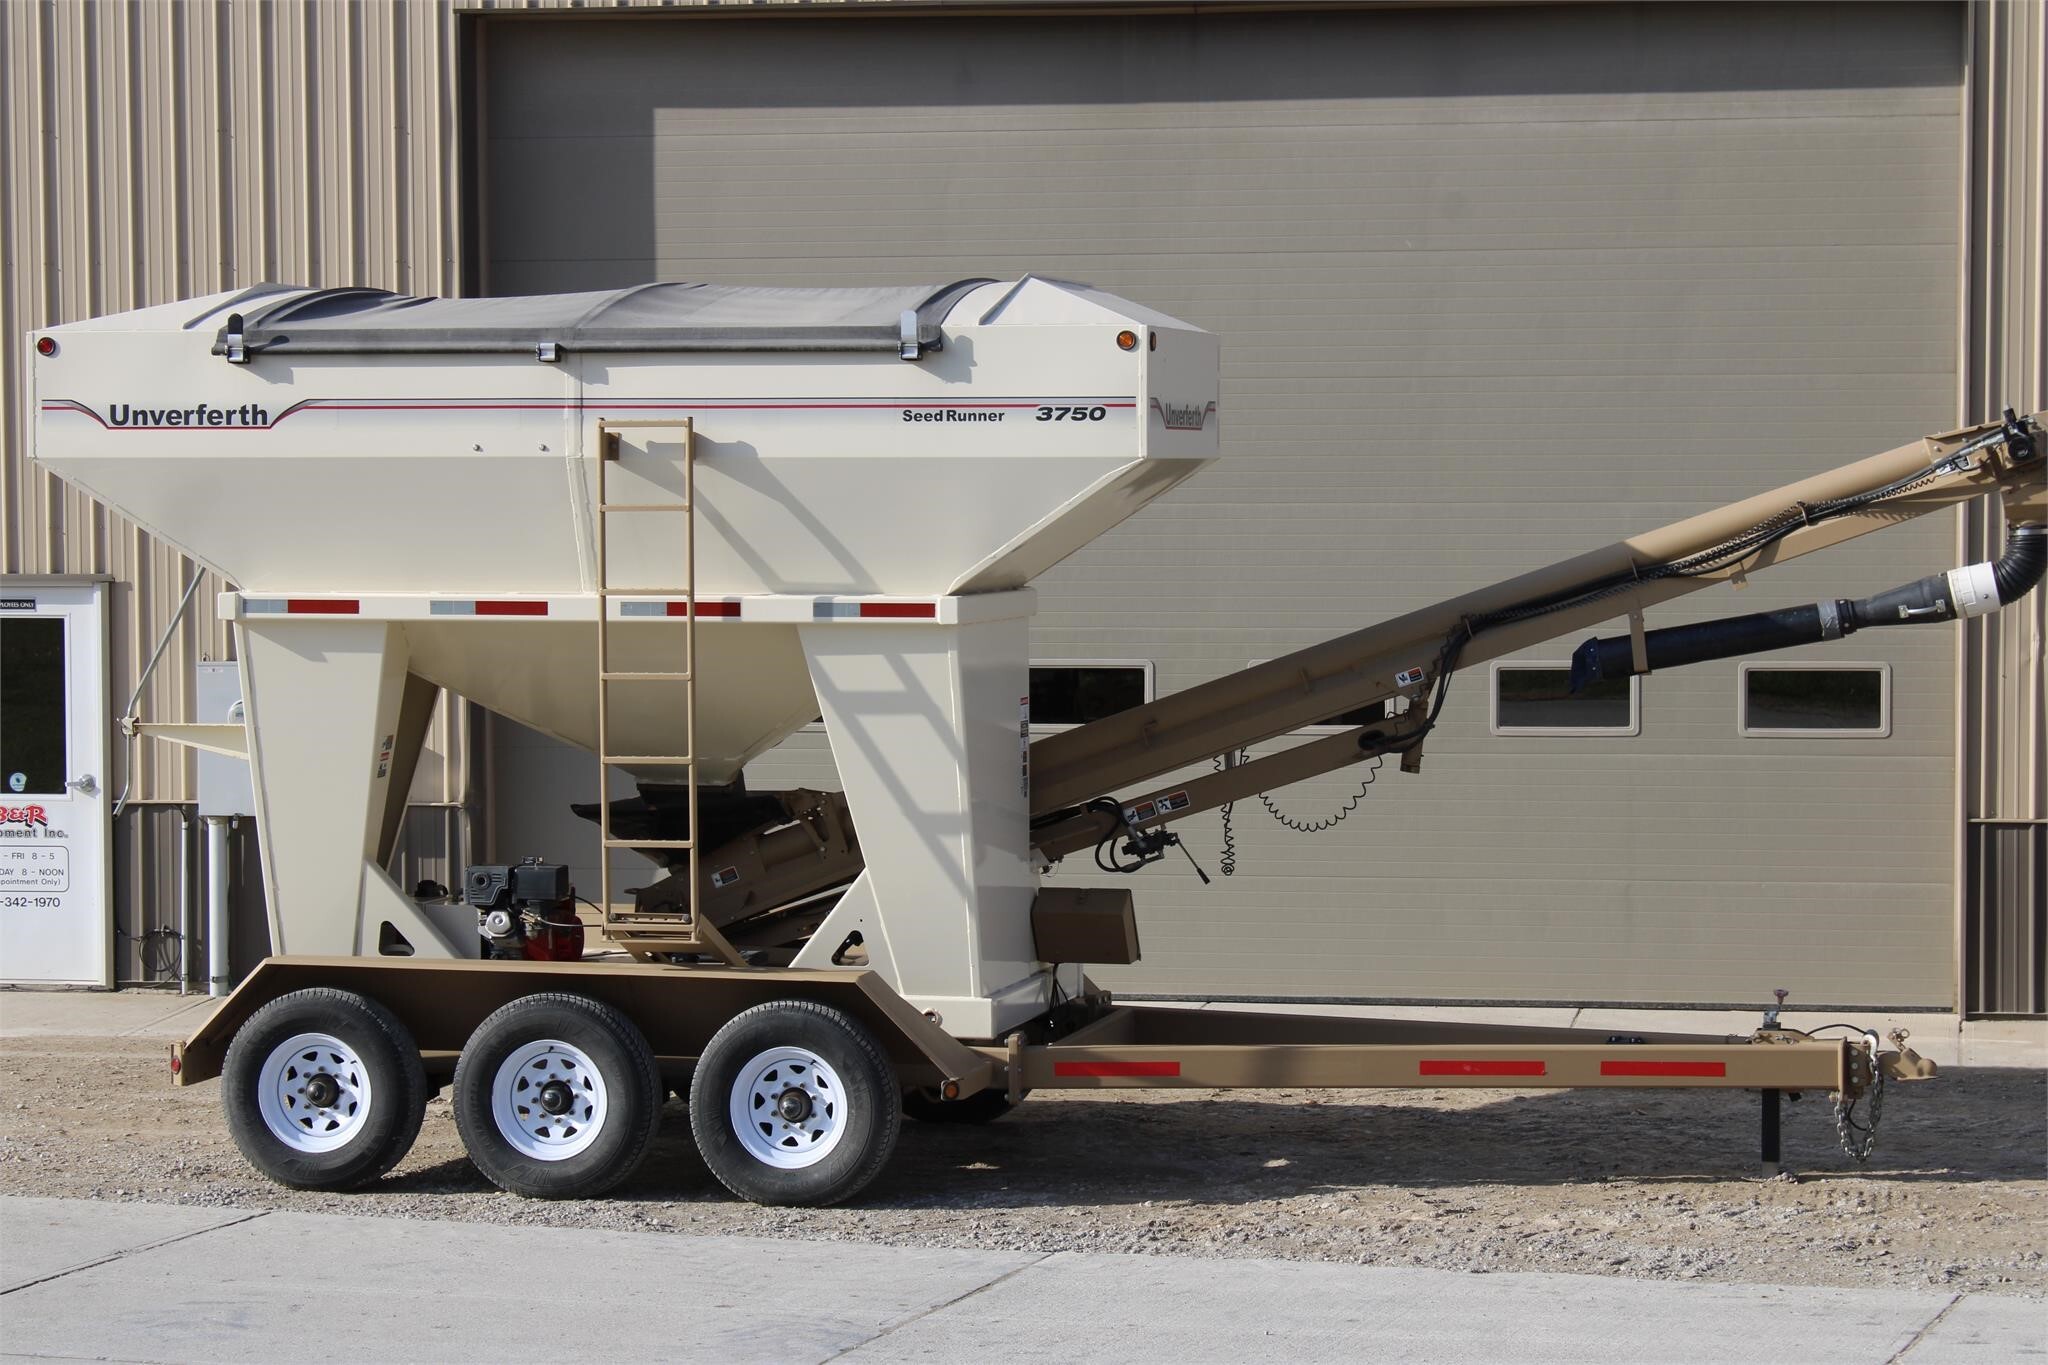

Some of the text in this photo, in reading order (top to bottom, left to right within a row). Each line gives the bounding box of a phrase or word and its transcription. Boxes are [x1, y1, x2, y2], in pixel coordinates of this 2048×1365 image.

[110, 403, 268, 426] Unverferth
[902, 409, 1005, 422] Seed Runner
[1035, 406, 1106, 421] 3750
[1165, 402, 1202, 426] Unverferth
[11, 852, 25, 860] FRI
[31, 852, 38, 860] 8
[49, 852, 55, 860] 5
[21, 868, 28, 876] 8
